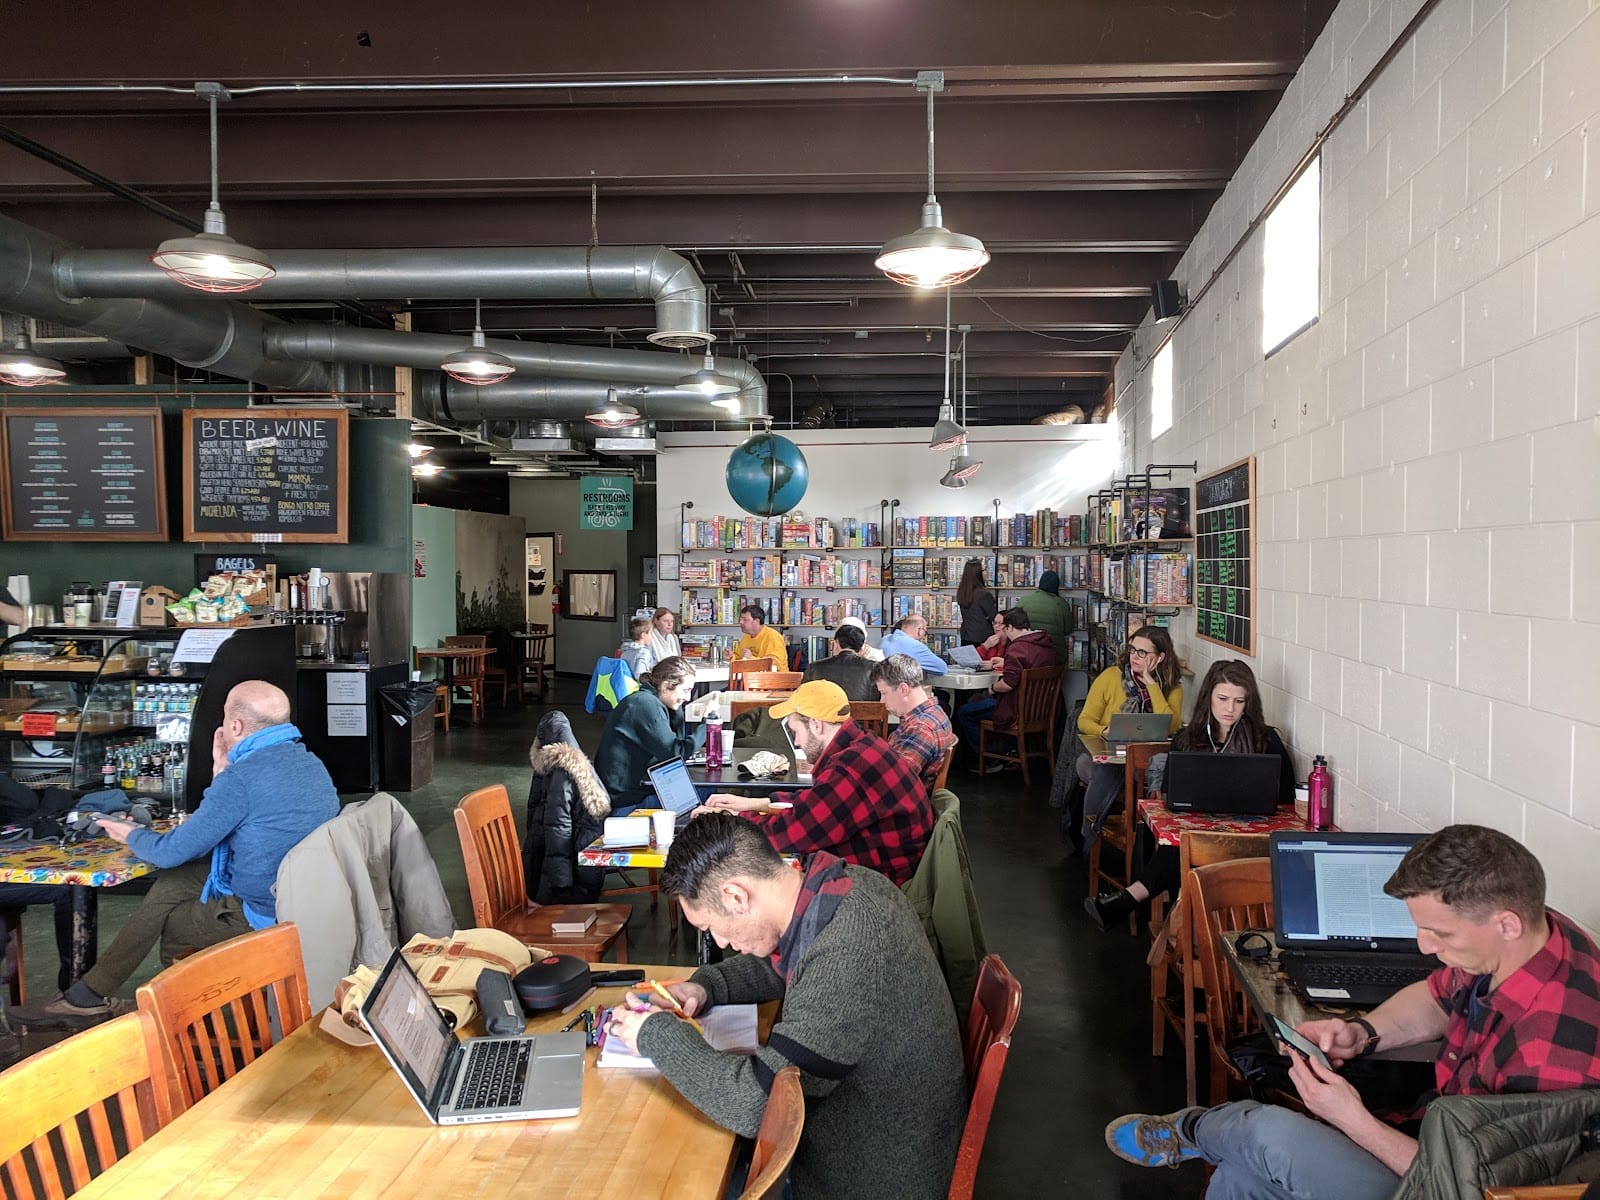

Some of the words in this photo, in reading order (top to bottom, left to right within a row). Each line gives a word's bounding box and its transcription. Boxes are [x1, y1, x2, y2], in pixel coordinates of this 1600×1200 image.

[202, 420, 256, 438] BEER
[275, 420, 326, 438] WINE
[583, 493, 630, 502] RESTROOMS
[216, 557, 255, 570] BAGELS
